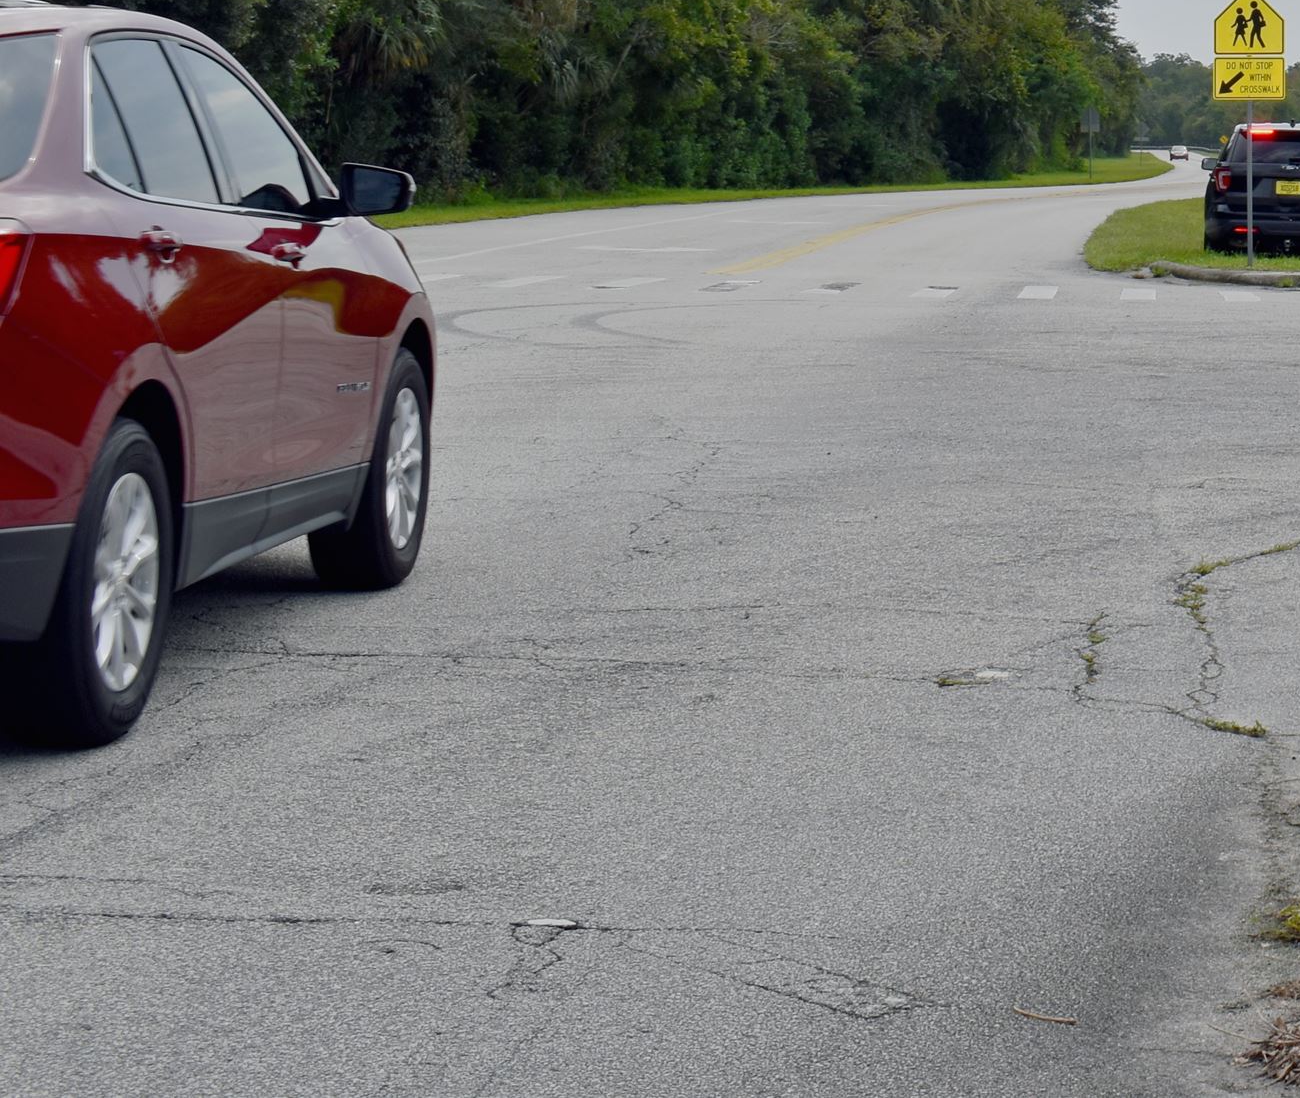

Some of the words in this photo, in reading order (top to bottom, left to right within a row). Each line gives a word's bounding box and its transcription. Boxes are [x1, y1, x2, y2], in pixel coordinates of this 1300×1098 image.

[1226, 62, 1236, 70] DO
[1239, 62, 1252, 70] NOT
[1255, 62, 1273, 70] STOP
[1249, 74, 1272, 82] WITHIN
[1240, 85, 1280, 94] CROSSWALK
